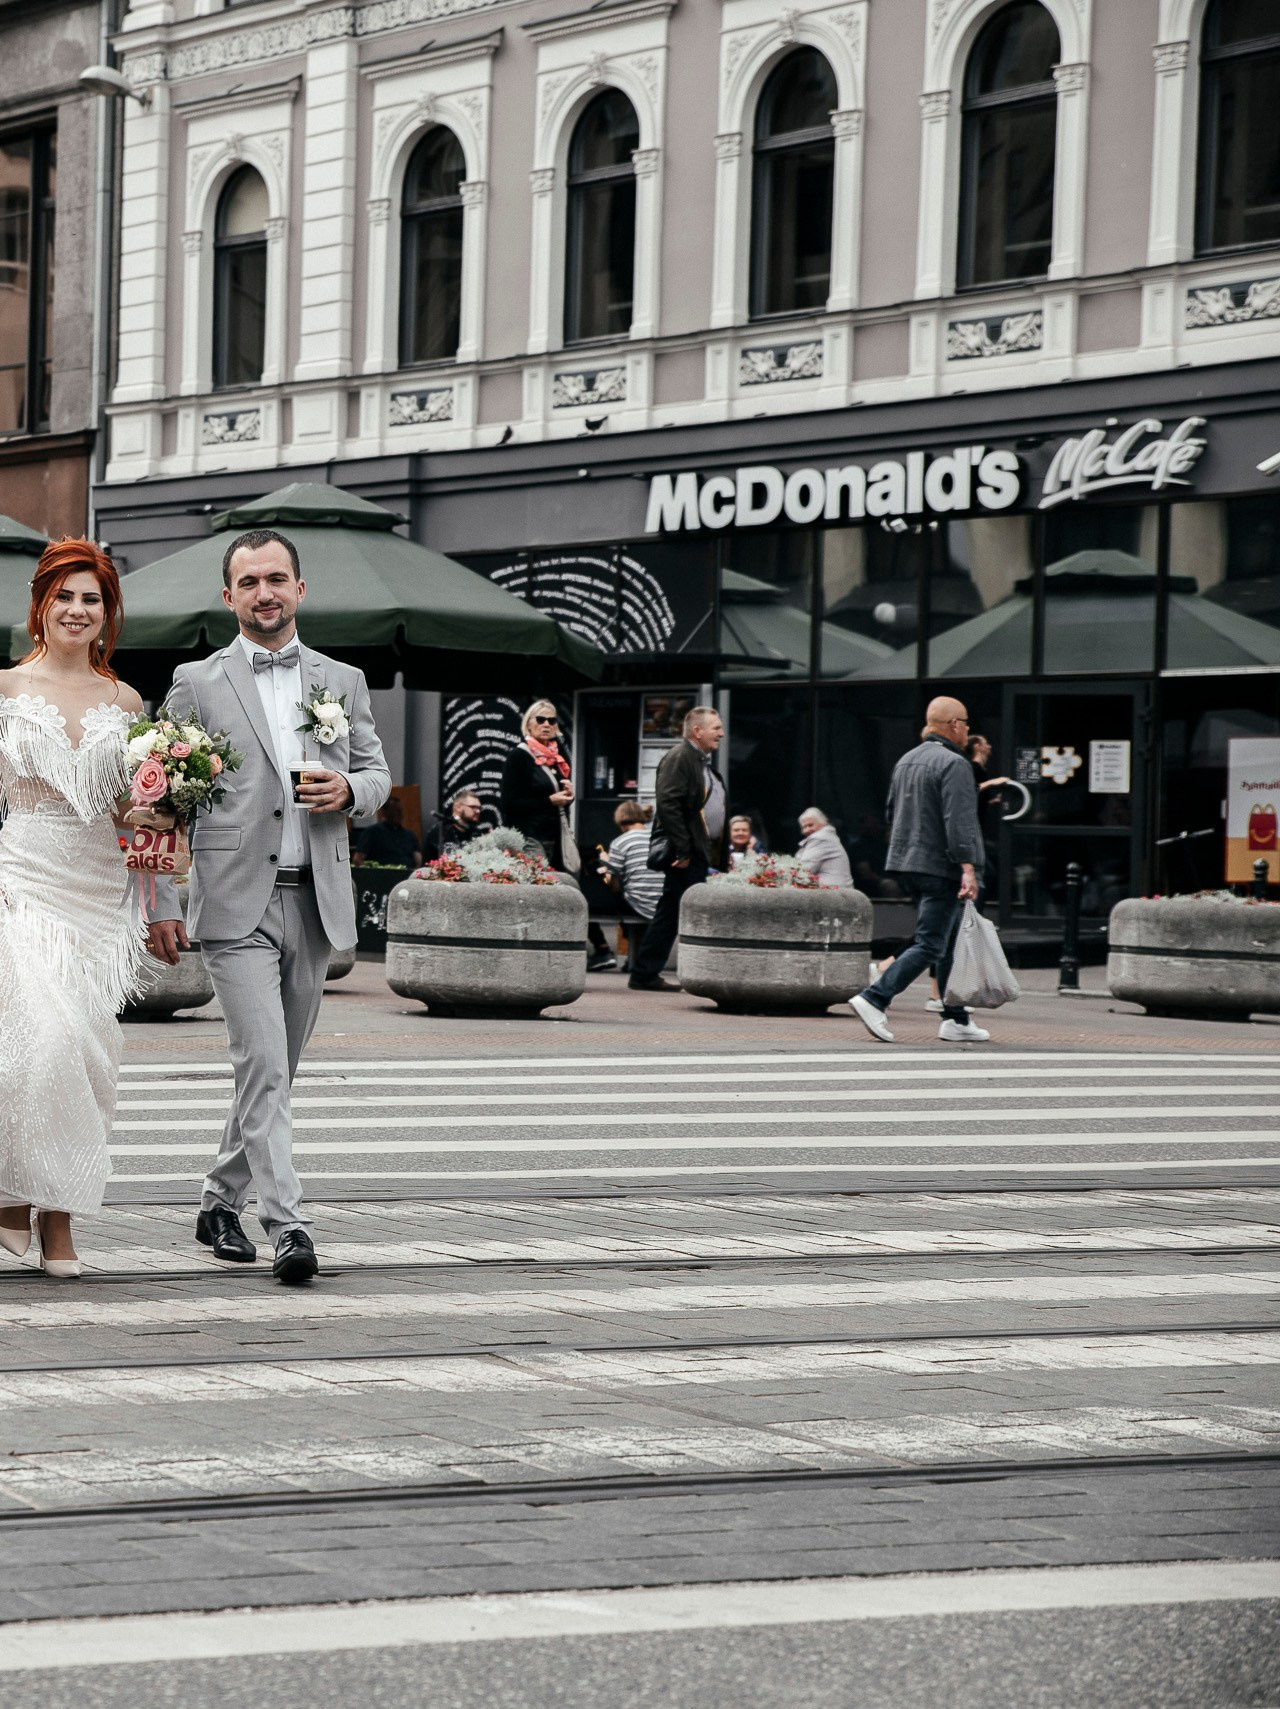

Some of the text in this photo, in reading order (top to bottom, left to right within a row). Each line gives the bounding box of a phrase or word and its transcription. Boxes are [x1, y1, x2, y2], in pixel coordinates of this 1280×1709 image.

[645, 446, 1020, 533] McDonald's
[130, 829, 177, 854] on
[126, 852, 175, 871] ald's
